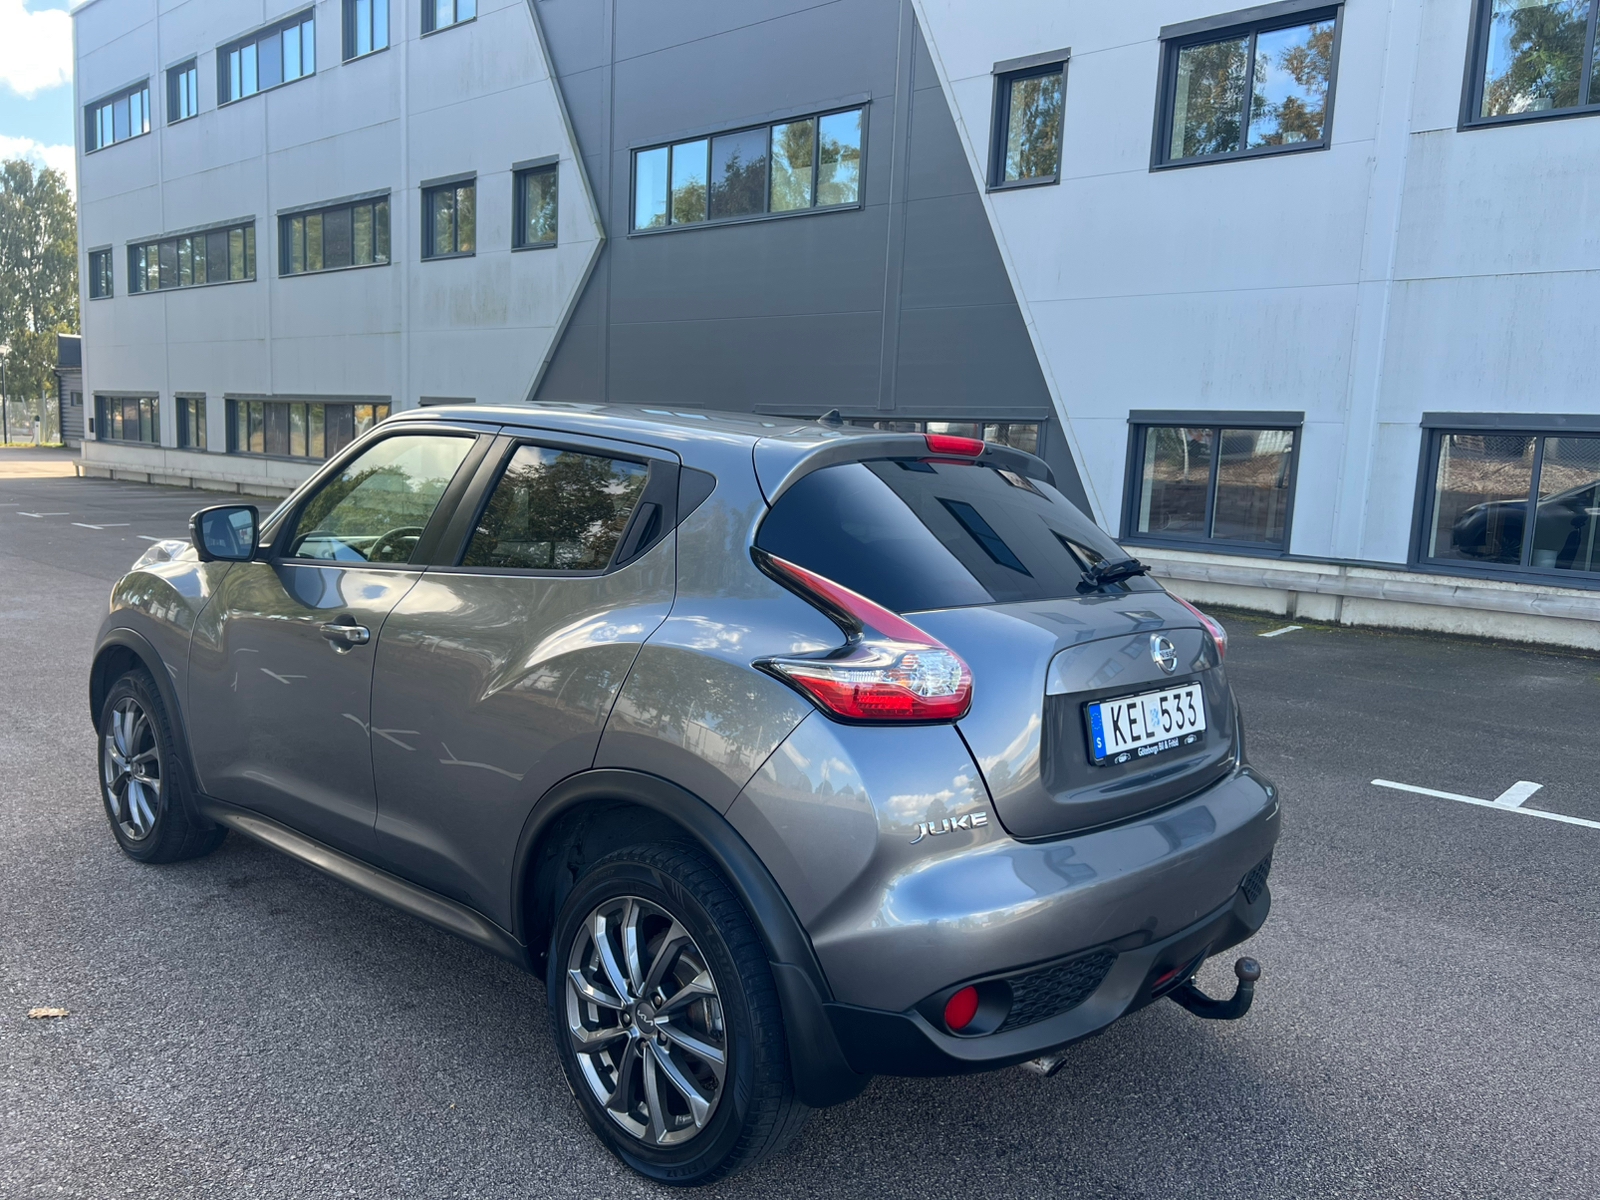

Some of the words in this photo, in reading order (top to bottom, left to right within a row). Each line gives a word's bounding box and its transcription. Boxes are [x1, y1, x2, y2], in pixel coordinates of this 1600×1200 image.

[1111, 701, 1155, 746] KEL
[1159, 691, 1197, 733] 533
[1096, 737, 1103, 748] S
[909, 812, 988, 845] JUKE
